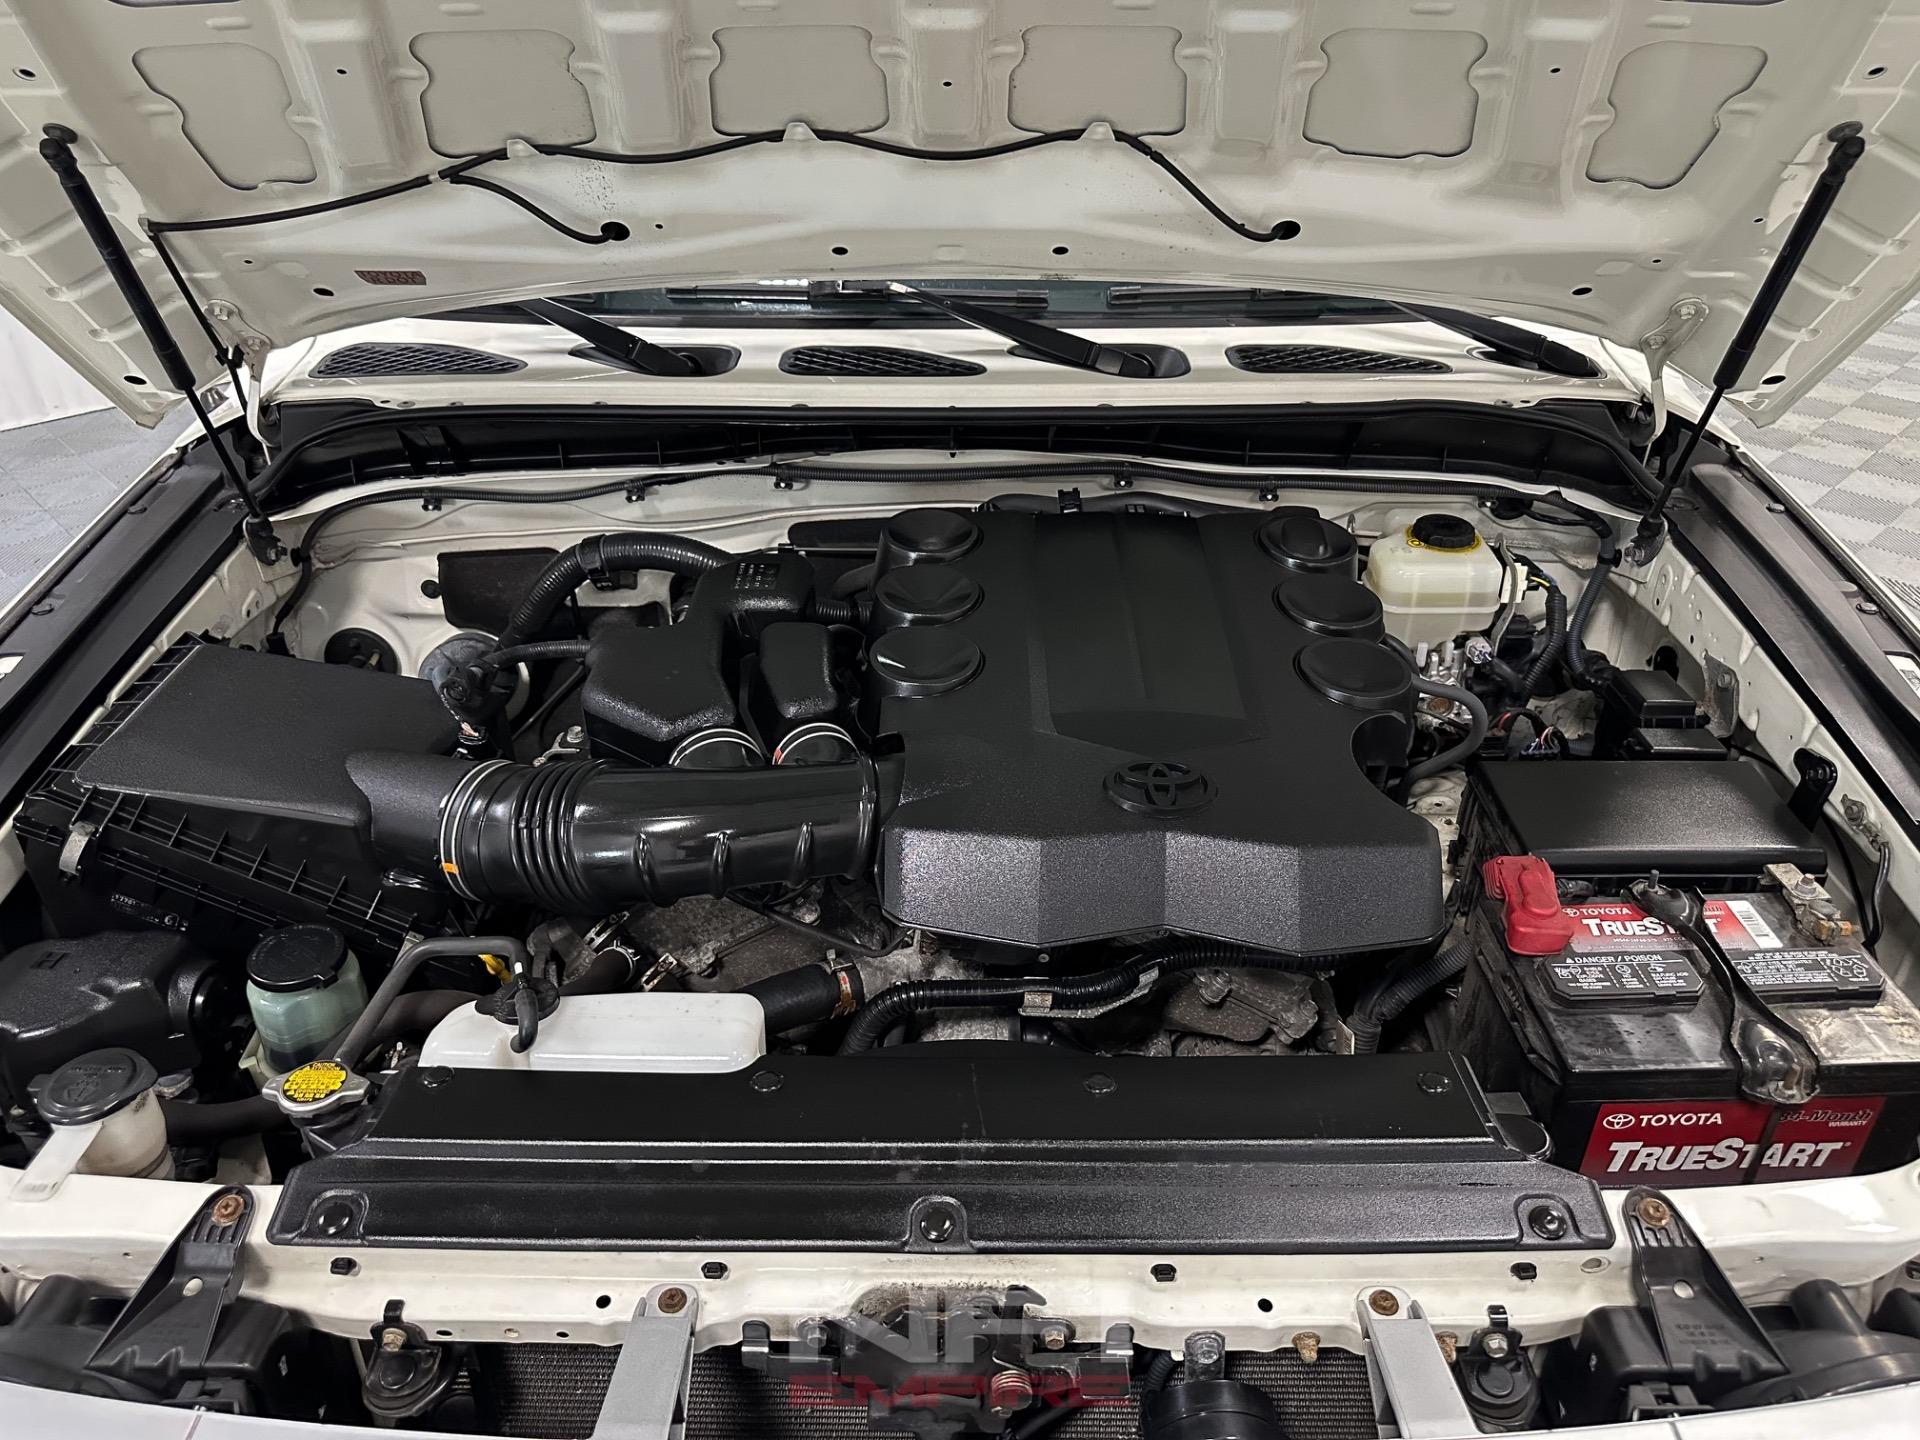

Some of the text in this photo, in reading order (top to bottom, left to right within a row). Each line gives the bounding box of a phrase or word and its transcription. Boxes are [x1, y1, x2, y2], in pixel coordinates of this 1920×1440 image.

[1581, 907, 1632, 916] TOYOTA
[1574, 956, 1615, 964] DANGER
[1625, 954, 1663, 962] POISON
[1640, 1112, 1723, 1126] TOYOTA
